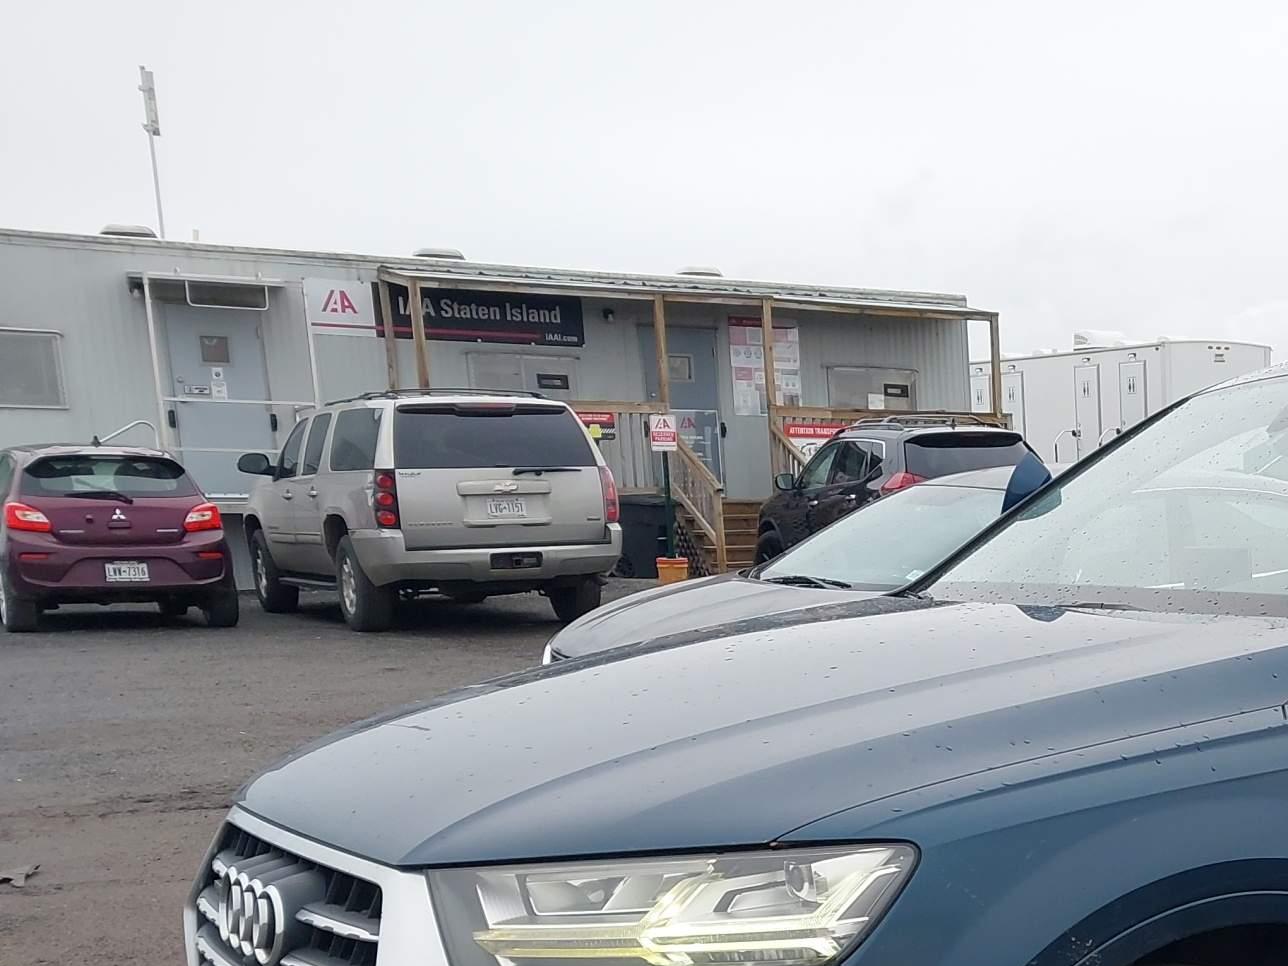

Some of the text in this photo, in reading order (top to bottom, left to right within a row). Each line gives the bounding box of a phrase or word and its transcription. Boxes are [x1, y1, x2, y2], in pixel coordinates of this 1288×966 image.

[398, 295, 562, 324] IA Staten Island
[789, 426, 815, 435] ATTENTION
